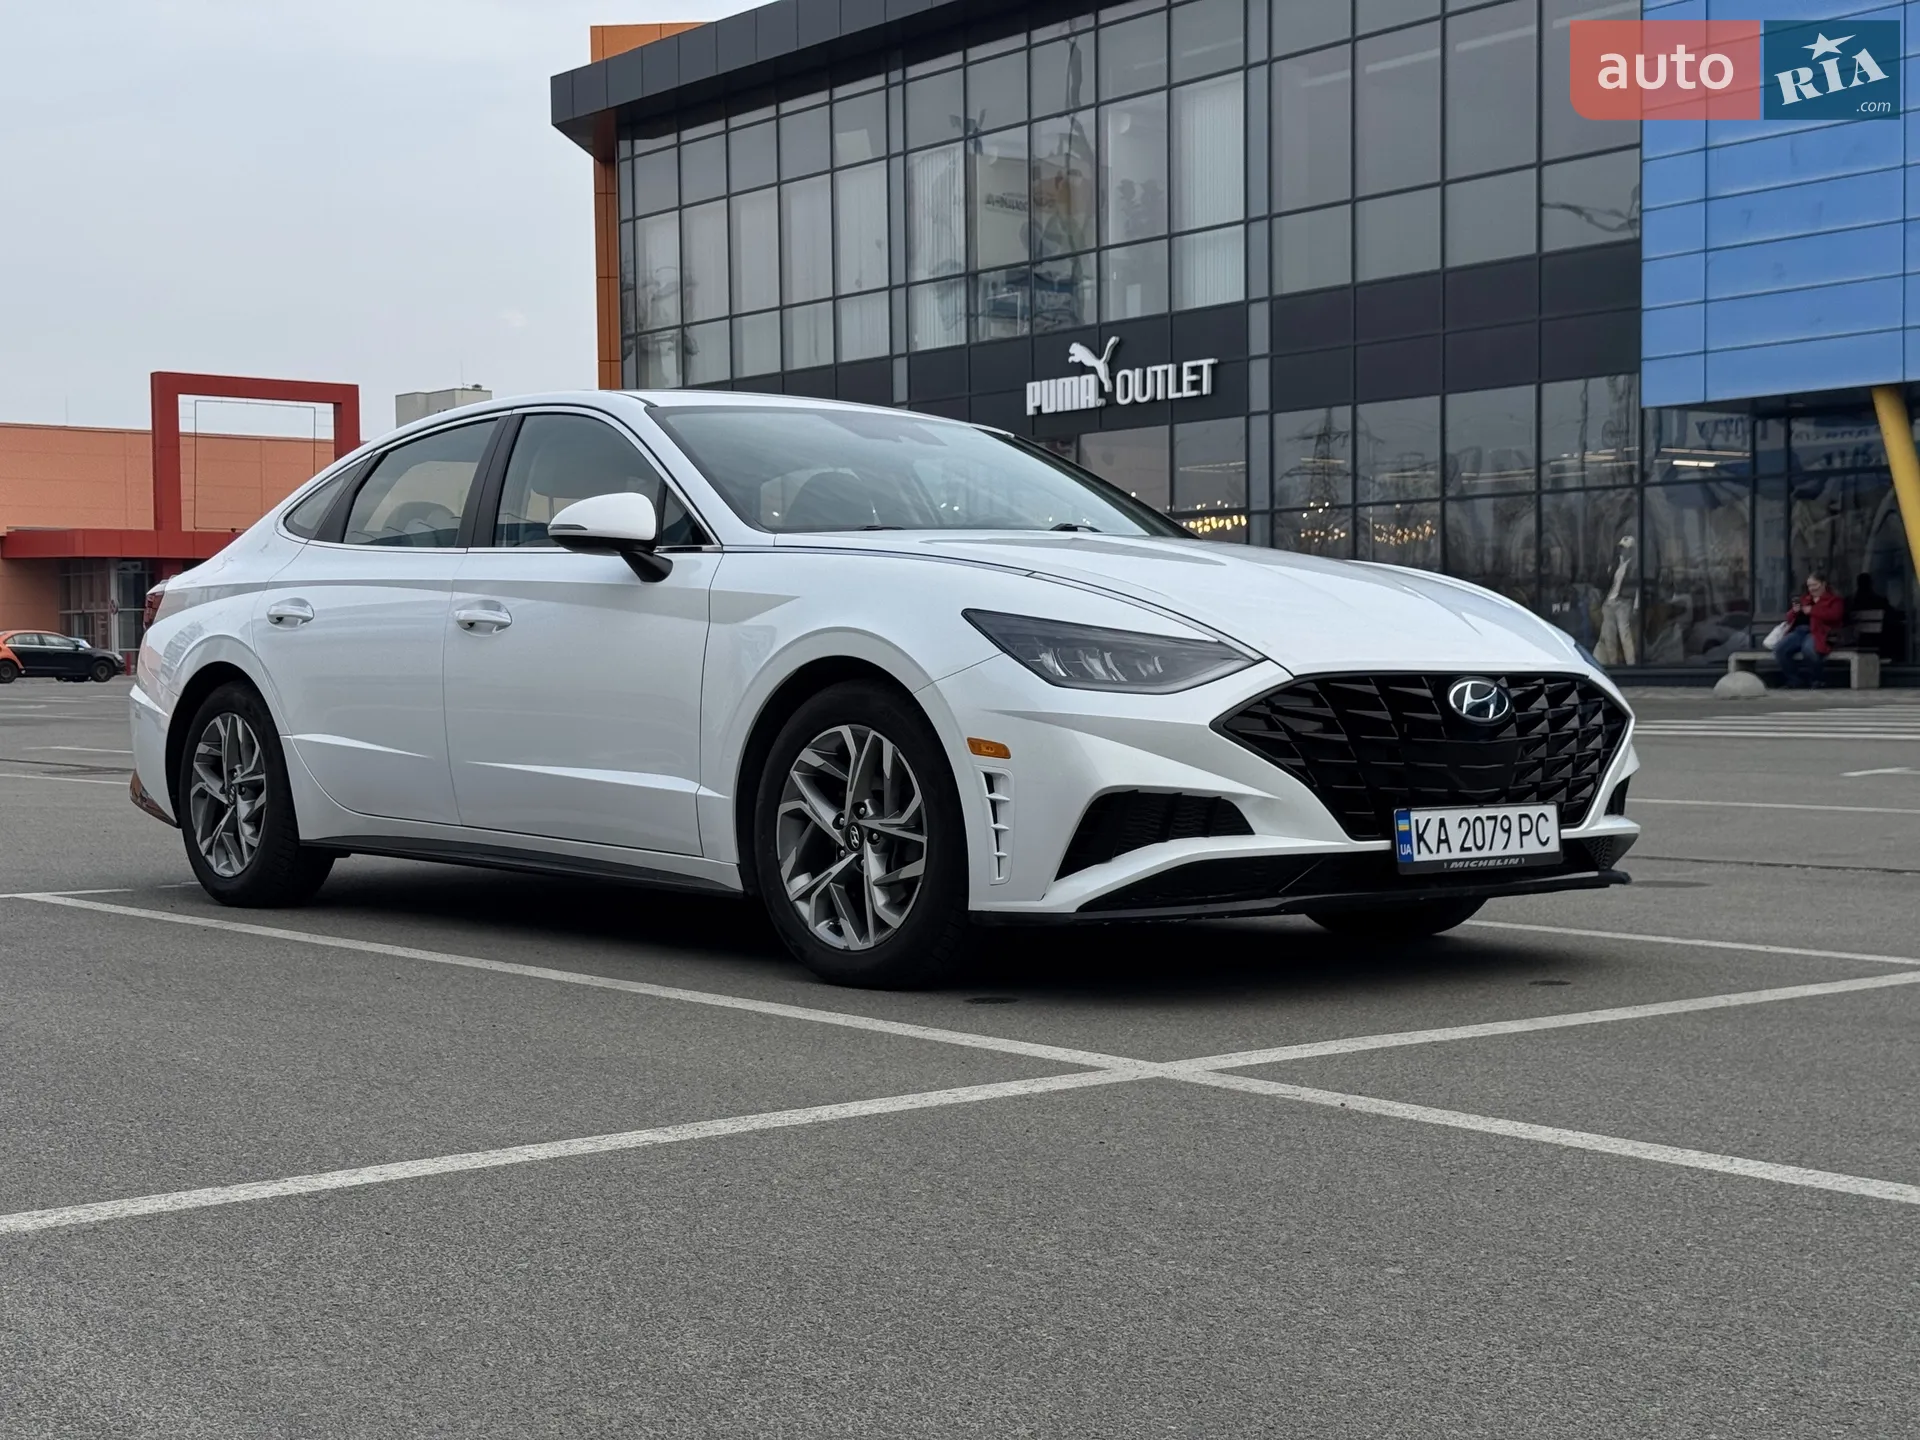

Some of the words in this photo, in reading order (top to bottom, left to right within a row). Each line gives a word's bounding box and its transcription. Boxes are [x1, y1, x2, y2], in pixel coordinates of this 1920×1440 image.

[1026, 373, 1099, 416] PUMA
[1116, 358, 1219, 406] OUTLET
[1415, 817, 1452, 855] KA
[1458, 814, 1512, 853] 2079
[1518, 812, 1550, 848] PC
[1400, 844, 1412, 856] UA
[1449, 857, 1520, 869] MICHELIN
